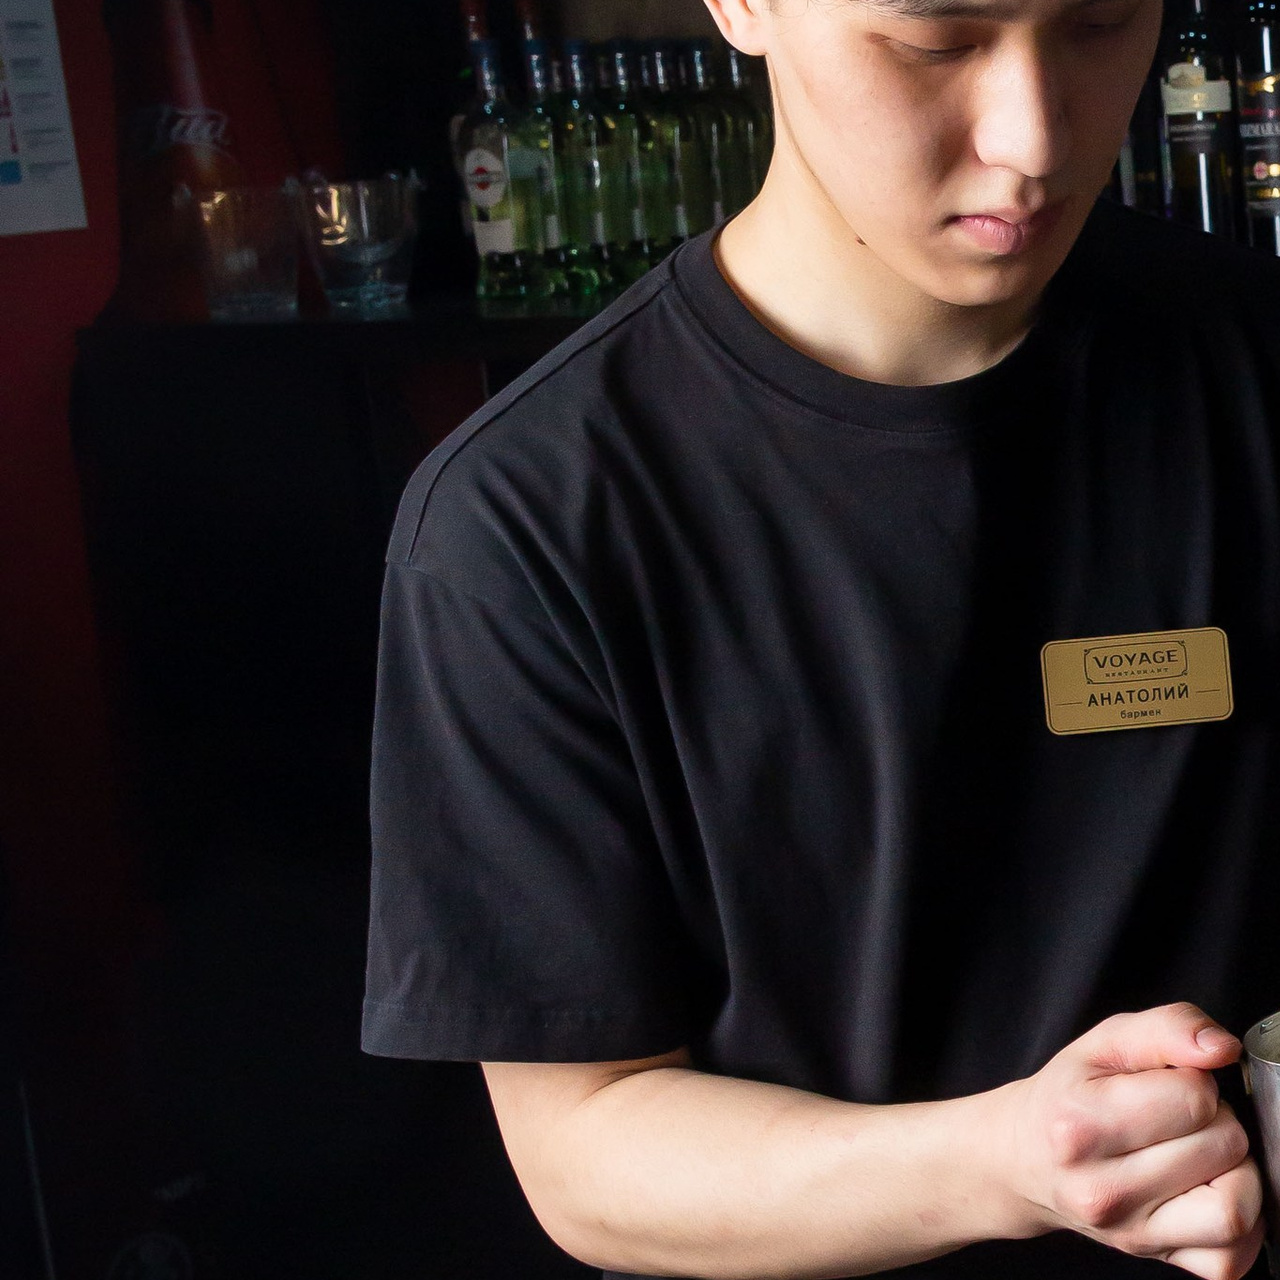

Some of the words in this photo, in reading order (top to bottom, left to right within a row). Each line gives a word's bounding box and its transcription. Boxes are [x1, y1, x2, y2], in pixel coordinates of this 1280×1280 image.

[1093, 649, 1178, 669] VOYAGE
[1105, 667, 1169, 678] RESTAURANT
[1087, 683, 1189, 708] АНАТОЛИЙ
[1120, 708, 1161, 719] бармен
